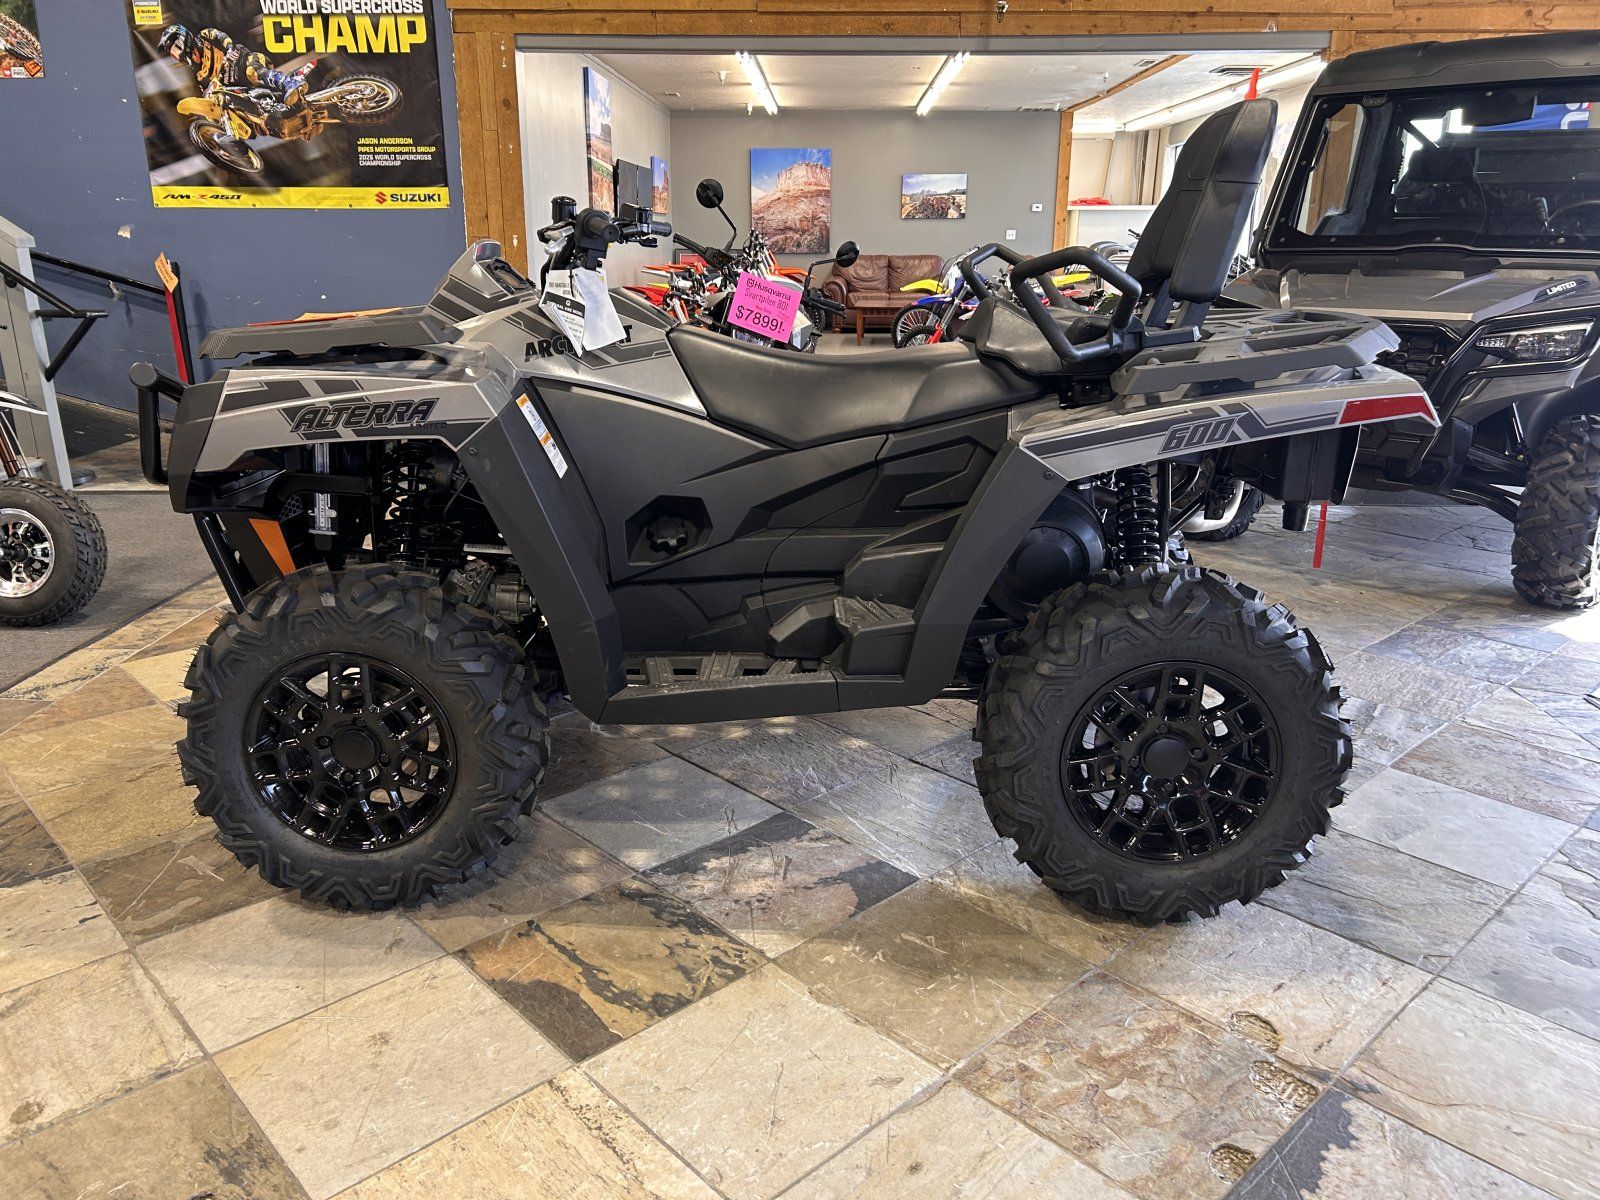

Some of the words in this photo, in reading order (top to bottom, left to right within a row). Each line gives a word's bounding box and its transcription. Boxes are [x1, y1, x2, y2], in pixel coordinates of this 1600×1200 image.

[260, 0, 317, 14] WORLD
[321, 0, 424, 14] SUPERCROSS
[262, 15, 427, 53] CHAMP
[390, 193, 442, 202] SUZUKI
[745, 288, 776, 306] Svartpilen
[754, 281, 791, 301] Husqvarna
[1546, 281, 1577, 295] LIMITED
[735, 305, 784, 334] $7899!
[290, 397, 440, 433] ALTERRA
[410, 421, 447, 431] LIMITED
[1160, 415, 1237, 453] 600
